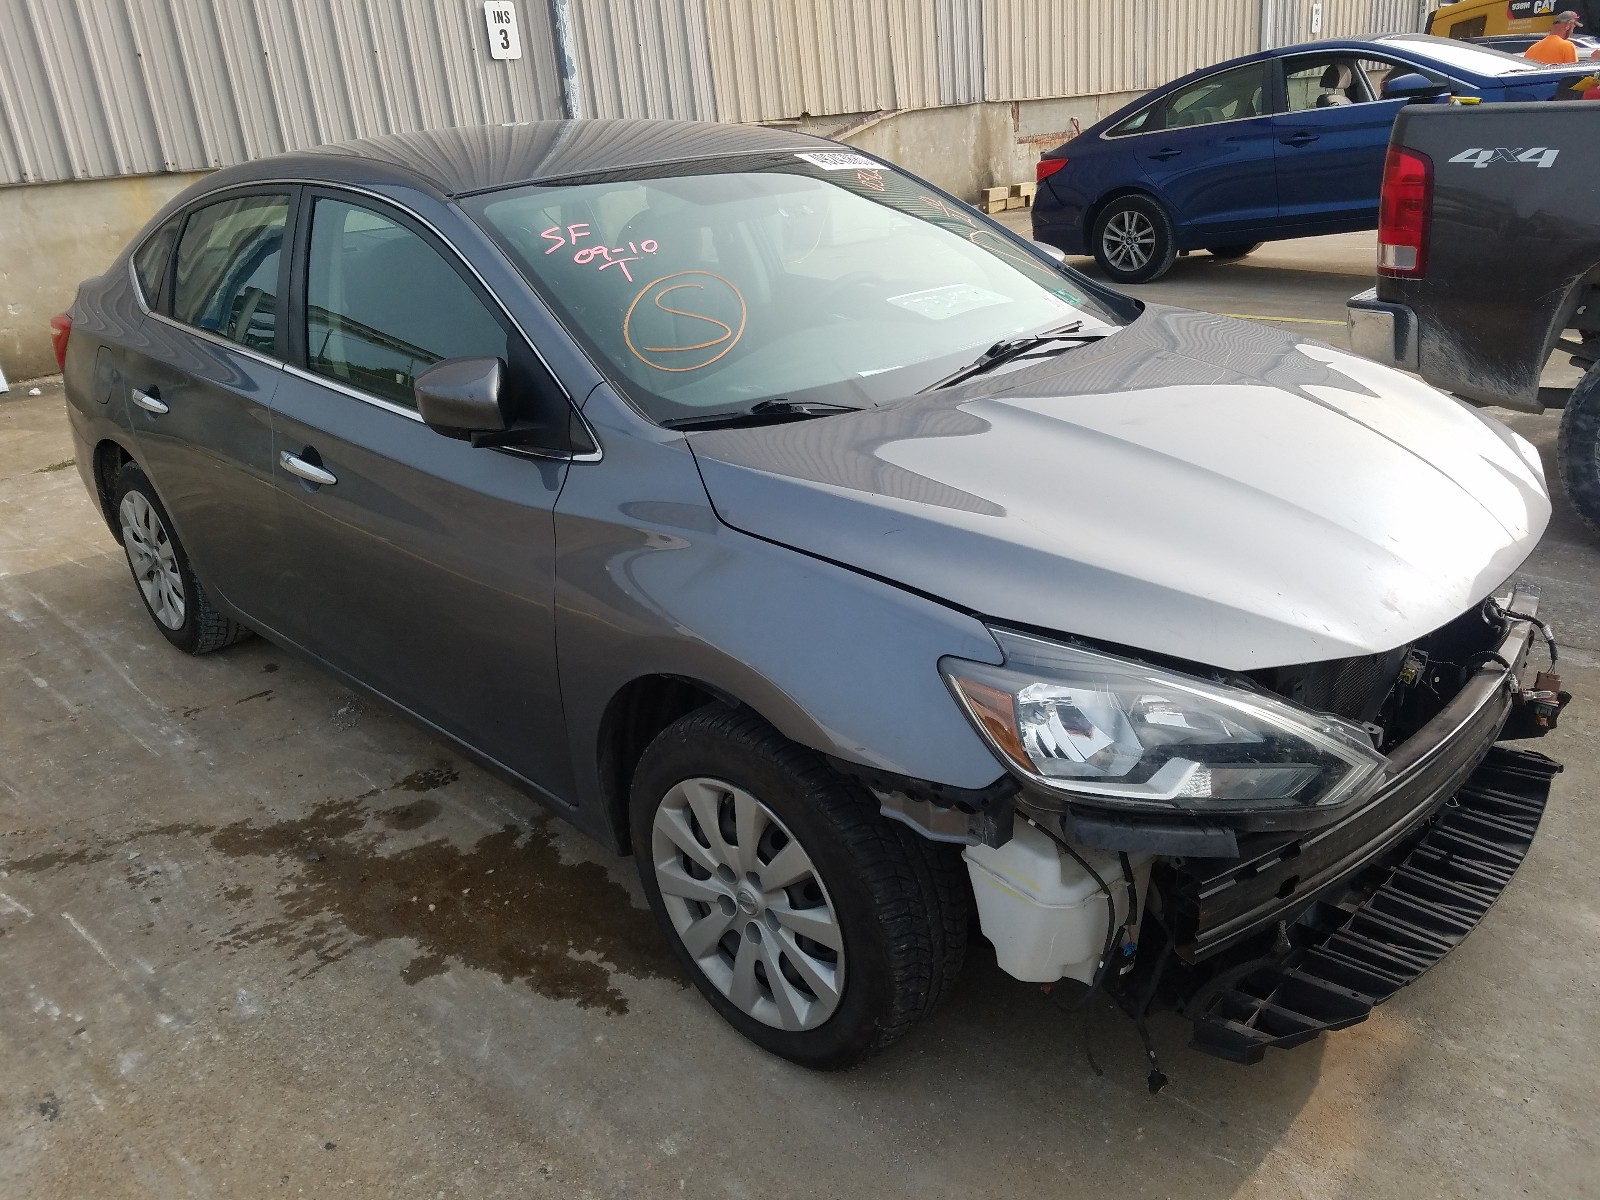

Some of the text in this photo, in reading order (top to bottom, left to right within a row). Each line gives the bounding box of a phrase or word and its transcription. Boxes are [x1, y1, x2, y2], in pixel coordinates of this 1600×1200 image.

[1533, 0, 1557, 14] CAT
[493, 11, 510, 24] INS
[499, 29, 510, 49] 3
